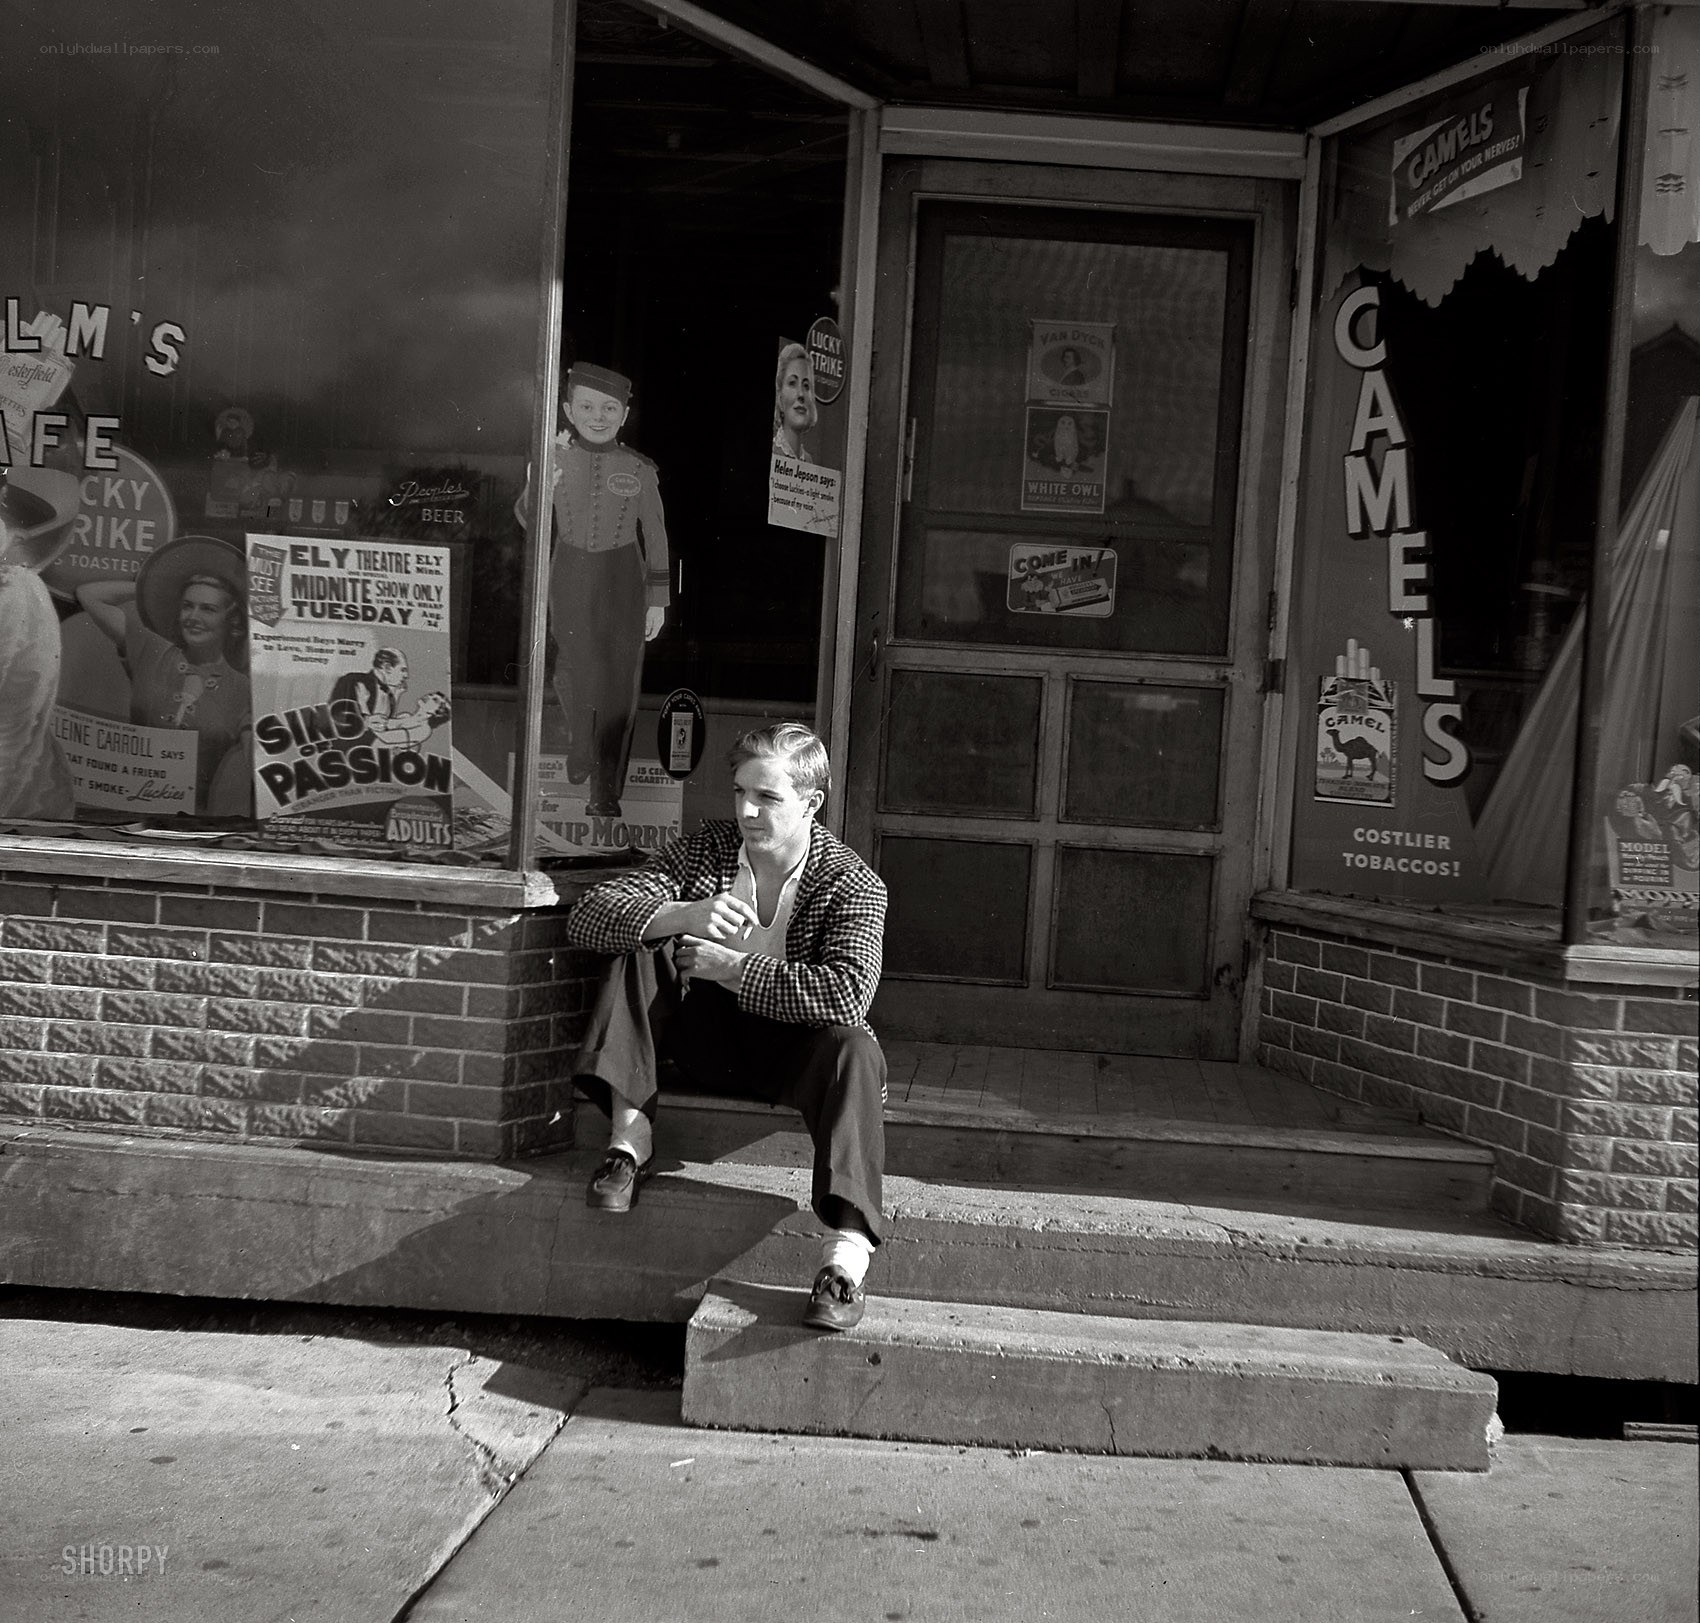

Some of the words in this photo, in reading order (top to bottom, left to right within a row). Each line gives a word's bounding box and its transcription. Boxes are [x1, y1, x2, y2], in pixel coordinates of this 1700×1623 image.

[1408, 103, 1495, 190] CAMELS
[1407, 192, 1432, 218] NEVER
[1433, 178, 1447, 196] GET
[1448, 169, 1460, 184] ON
[1460, 153, 1483, 175] YOUR
[1484, 134, 1521, 162] NERVES!
[811, 329, 841, 355] LUCKY
[1040, 331, 1068, 346] VAN
[809, 351, 843, 377] STRIKE
[774, 459, 794, 477] Helen
[794, 465, 818, 483] Jepson
[819, 476, 837, 489] says:
[79, 475, 150, 512] CKY
[1028, 482, 1067, 495] WHITE
[1071, 484, 1100, 497] OWL
[411, 508, 465, 524] BEER
[69, 513, 156, 552] RIKE
[1335, 286, 1470, 785] CAMELS
[248, 556, 284, 577] MUST
[290, 544, 351, 569] ELY
[356, 549, 412, 574] THEATRE
[415, 554, 444, 566] ELY
[415, 566, 444, 576] Minn.
[1014, 550, 1068, 574] COME
[249, 576, 275, 594] SEE
[291, 574, 372, 604] MIDNITE
[375, 581, 410, 599] SHOW
[413, 583, 444, 602] ONLY
[1060, 575, 1082, 585] HAVE
[292, 600, 413, 626] TUESDAY
[421, 610, 444, 620] Aug.
[256, 698, 366, 755] SINS
[1325, 715, 1385, 733] CAMEL
[55, 716, 90, 746] LEINE
[96, 728, 153, 758] CARROLL
[160, 750, 185, 760] SAYS
[86, 758, 117, 773] FOUND
[122, 766, 129, 775] A
[132, 767, 167, 779] FRIEND
[257, 745, 452, 808] PASSION
[637, 767, 646, 775] 15
[387, 818, 452, 845] ADULTS
[1353, 826, 1451, 850] COSTLIER
[1619, 842, 1671, 854] MODEL
[1342, 852, 1461, 877] TOBACCOS!
